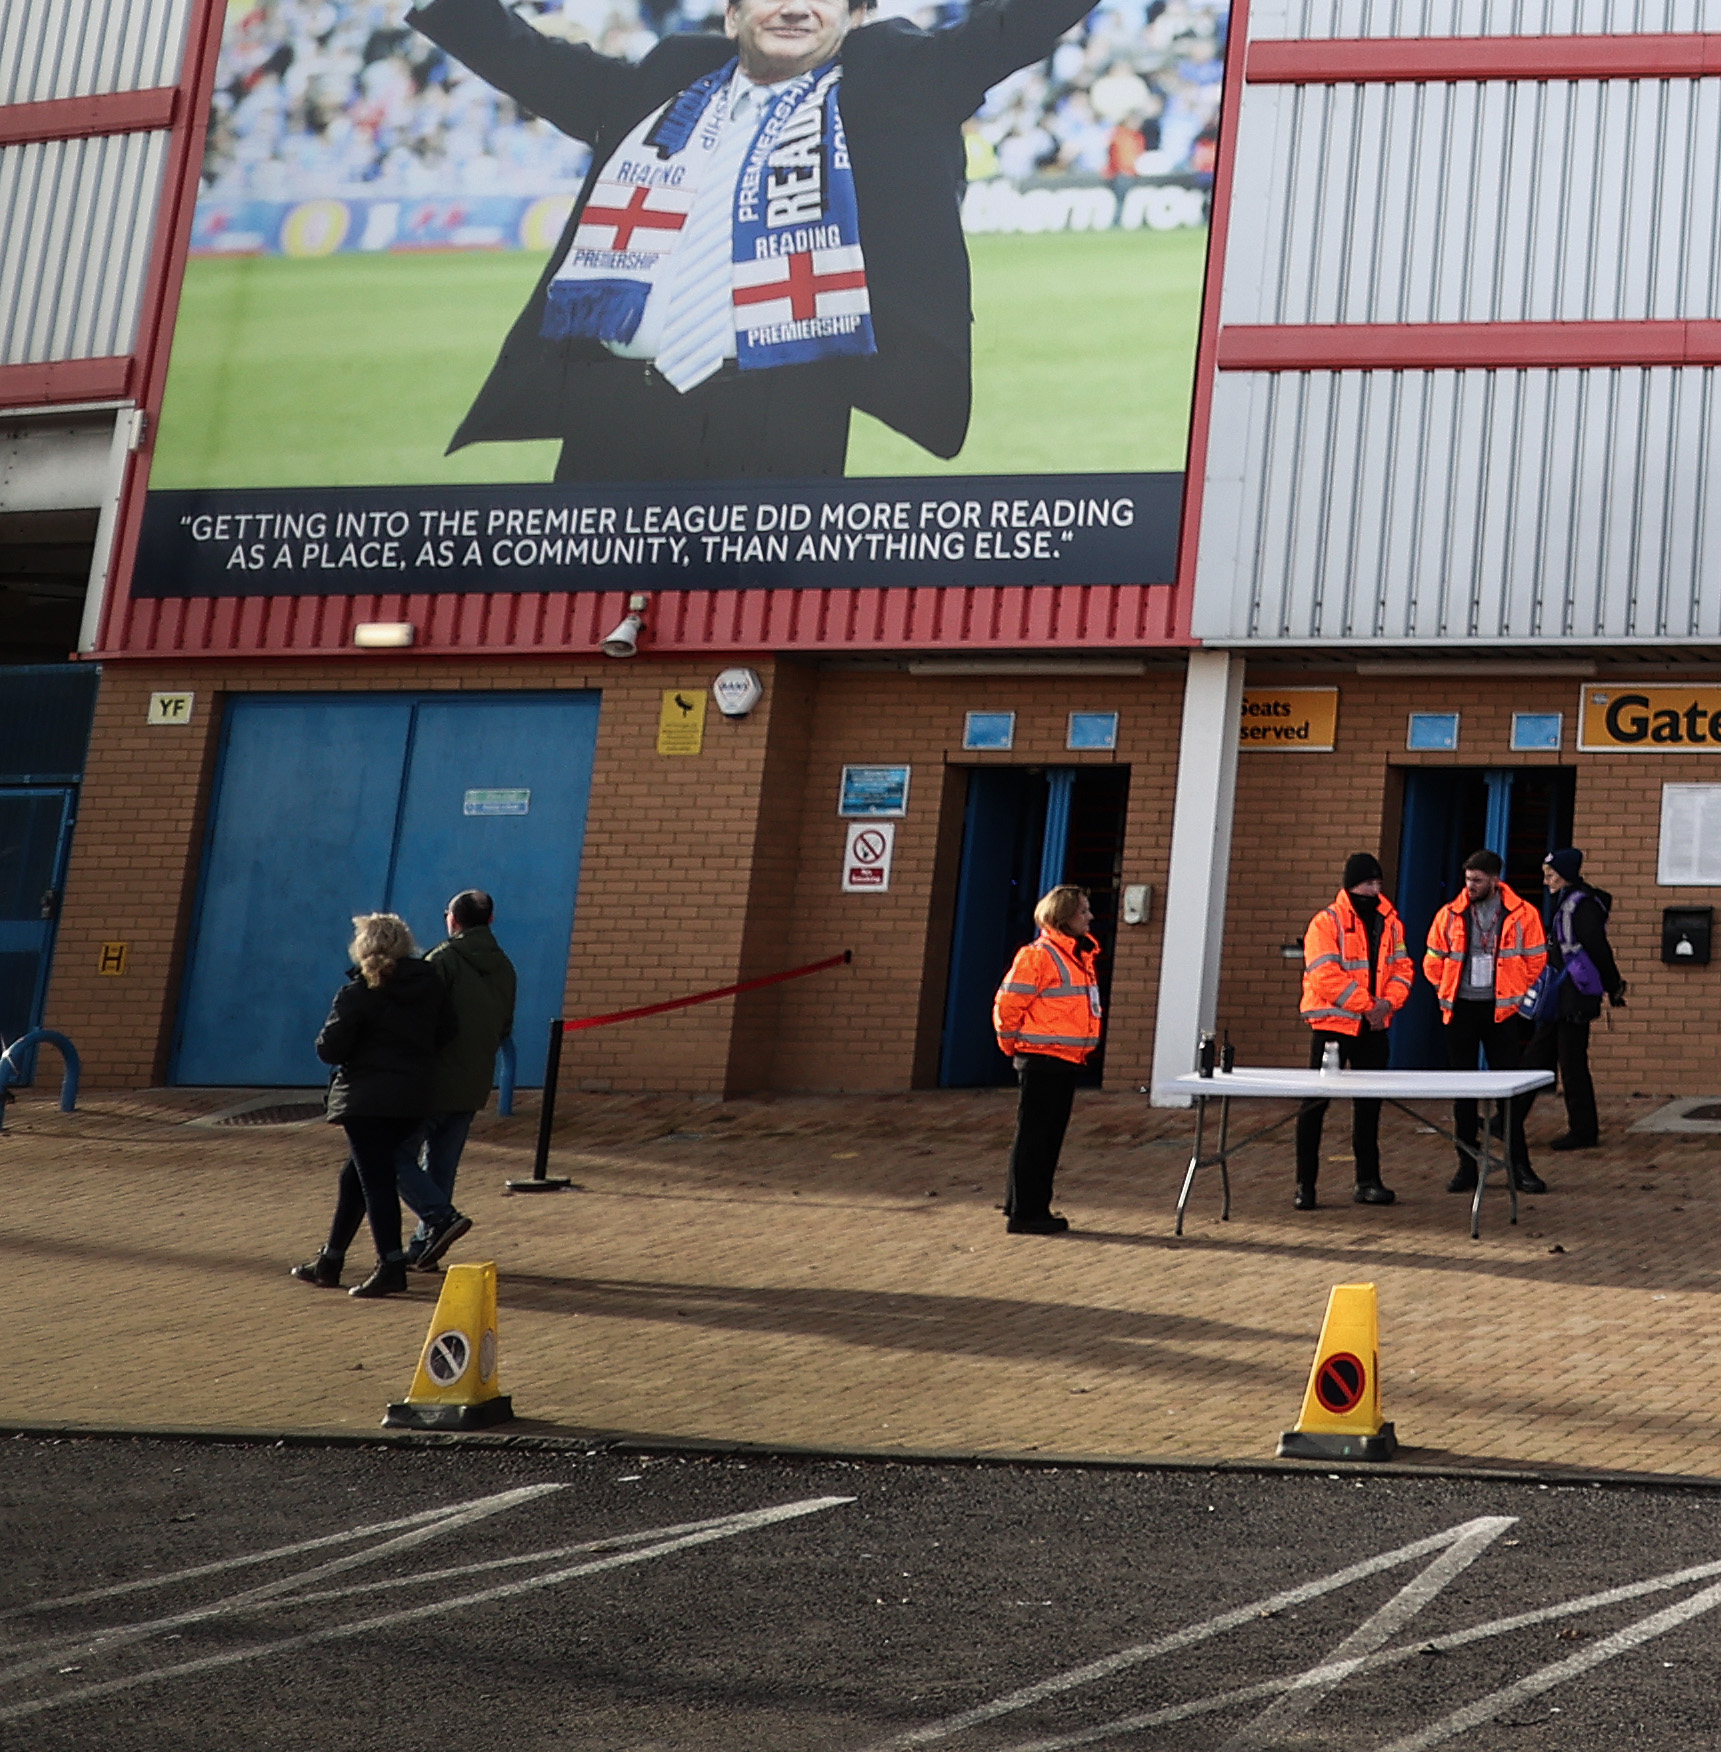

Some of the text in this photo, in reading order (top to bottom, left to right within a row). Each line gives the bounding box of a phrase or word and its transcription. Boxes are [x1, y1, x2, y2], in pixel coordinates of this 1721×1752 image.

[755, 224, 842, 259] READING
[747, 315, 862, 347] PREMIERSHIP
[335, 512, 410, 538] INTO
[419, 510, 480, 537] THE
[488, 507, 617, 536] PREMIER
[626, 504, 749, 534] LEAGUE
[755, 503, 812, 532] DID
[820, 502, 912, 531] MORE
[920, 500, 982, 530] FOR
[990, 498, 1135, 528] READING
[226, 544, 265, 569] AS
[273, 543, 293, 569] A
[302, 541, 406, 570] PLACE,
[415, 540, 455, 567] AS
[462, 540, 483, 567] A
[492, 536, 690, 566] COMMUNITY,
[700, 535, 789, 563] THAN
[796, 532, 966, 562] ANYTHING
[160, 699, 185, 716] YF
[1240, 721, 1310, 740] served
[102, 946, 123, 971] H
